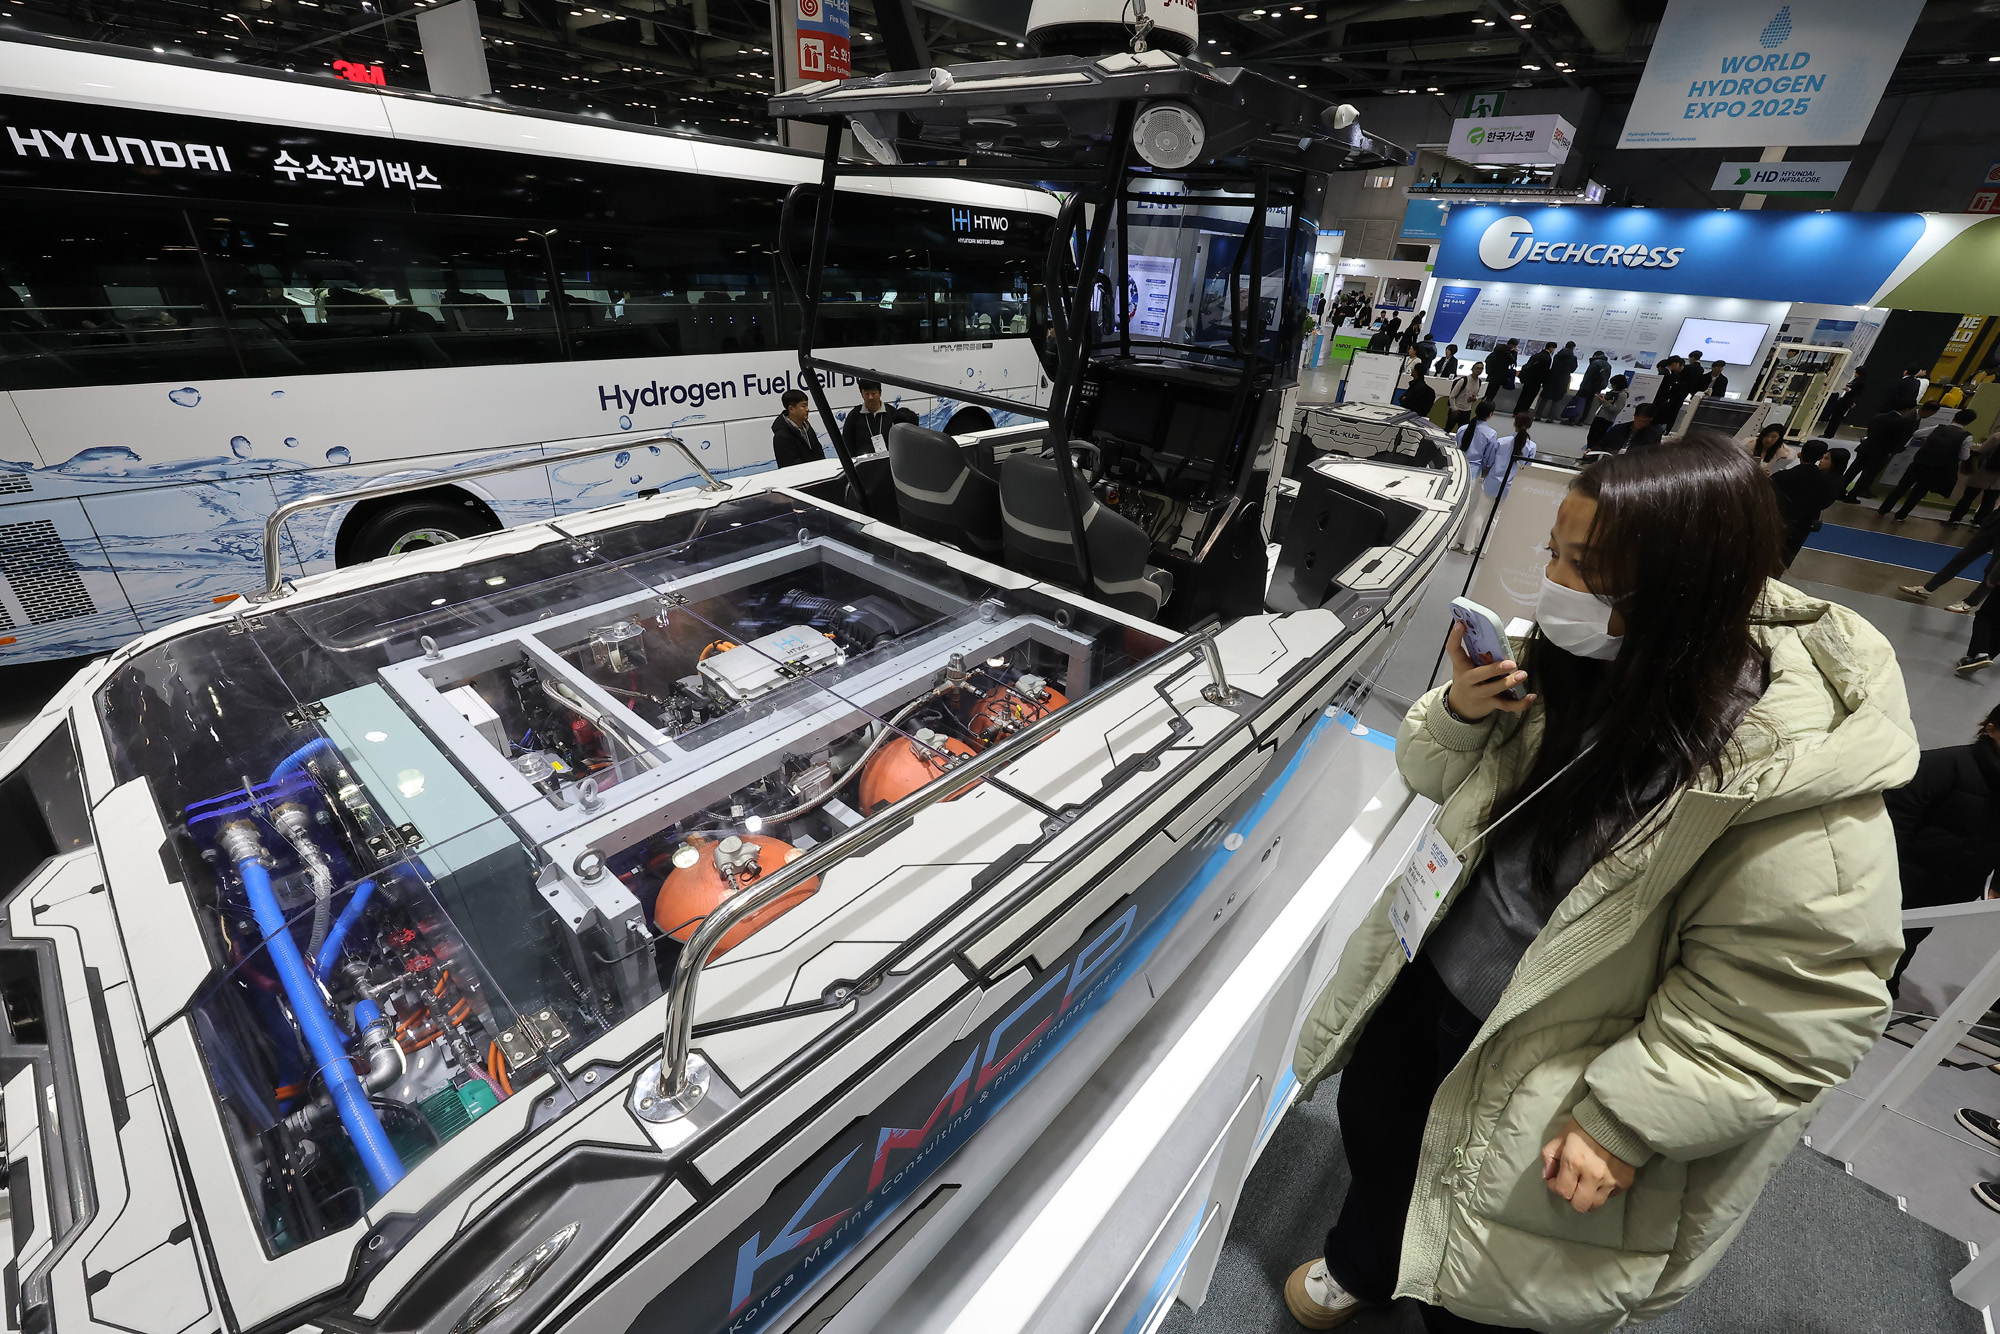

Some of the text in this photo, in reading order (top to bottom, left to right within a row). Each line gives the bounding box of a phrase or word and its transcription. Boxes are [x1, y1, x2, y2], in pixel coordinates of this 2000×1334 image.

[333, 60, 386, 86] 3M
[1721, 52, 1811, 74] WORLD
[1687, 74, 1827, 98] HYDROGEN
[1683, 97, 1811, 119] EXPO 2025
[1487, 130, 1535, 143] 한국가스젠
[6, 126, 232, 173] HYUNDAI
[273, 149, 442, 191] 수소전기버스
[1753, 171, 1778, 183] HD
[974, 214, 1009, 231] HTWO
[1479, 216, 1685, 270] TECHCROSS
[598, 380, 737, 415] Hydrogen
[743, 370, 790, 397] Fuel
[1329, 429, 1361, 440] EL-KUS
[786, 643, 810, 656] HTWO
[1432, 841, 1449, 867] HYUNDAI
[1427, 860, 1437, 874] 3M
[728, 903, 1138, 1319] KMCP
[729, 962, 1122, 1334] Korea Marine Consulting & Project management
